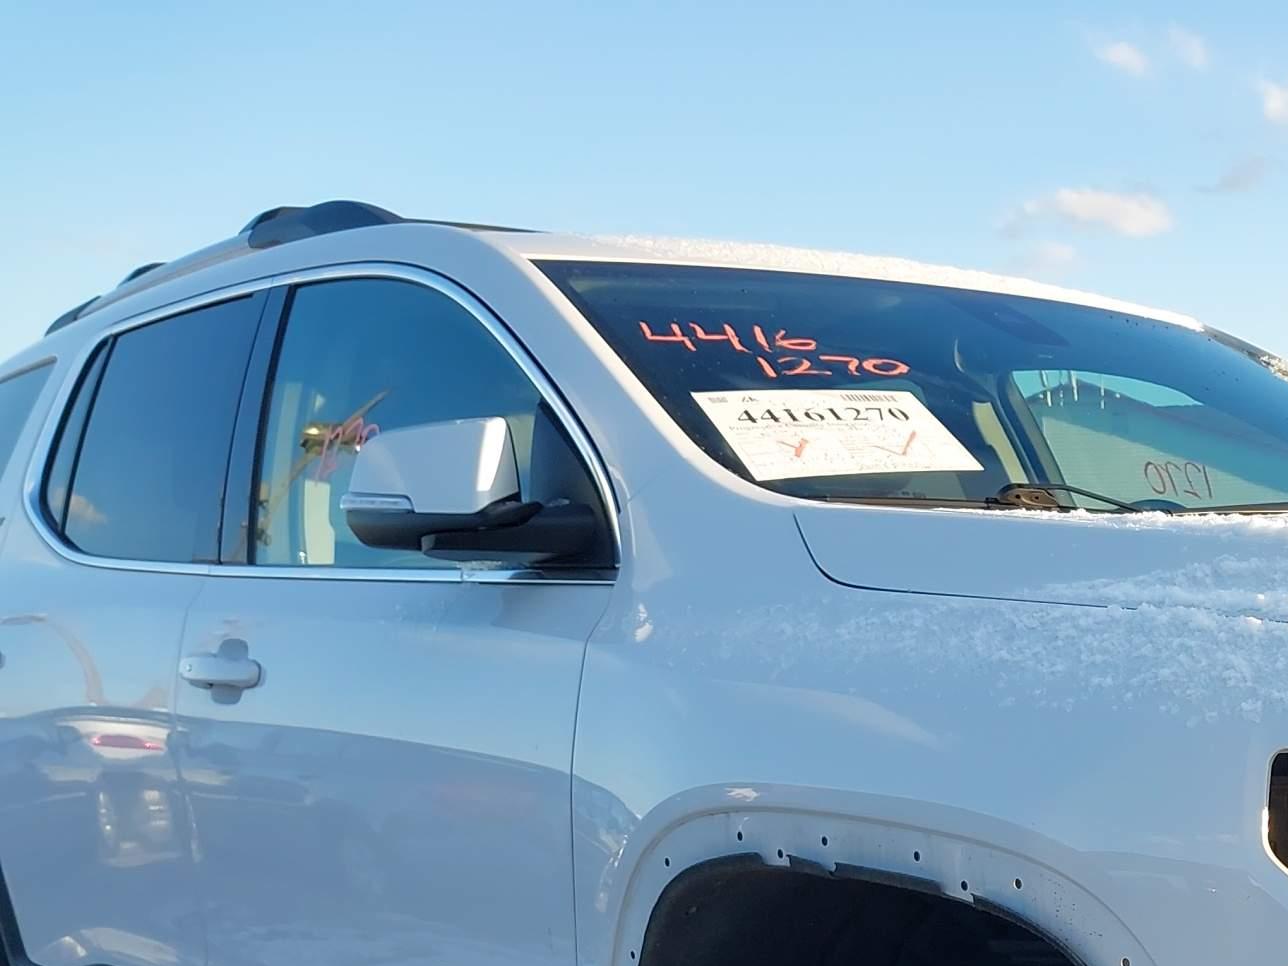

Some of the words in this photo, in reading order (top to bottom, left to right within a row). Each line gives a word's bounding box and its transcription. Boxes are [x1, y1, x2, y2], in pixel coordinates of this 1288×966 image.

[639, 321, 817, 353] 4416
[756, 355, 911, 378] 1270
[736, 406, 910, 424] 44161270
